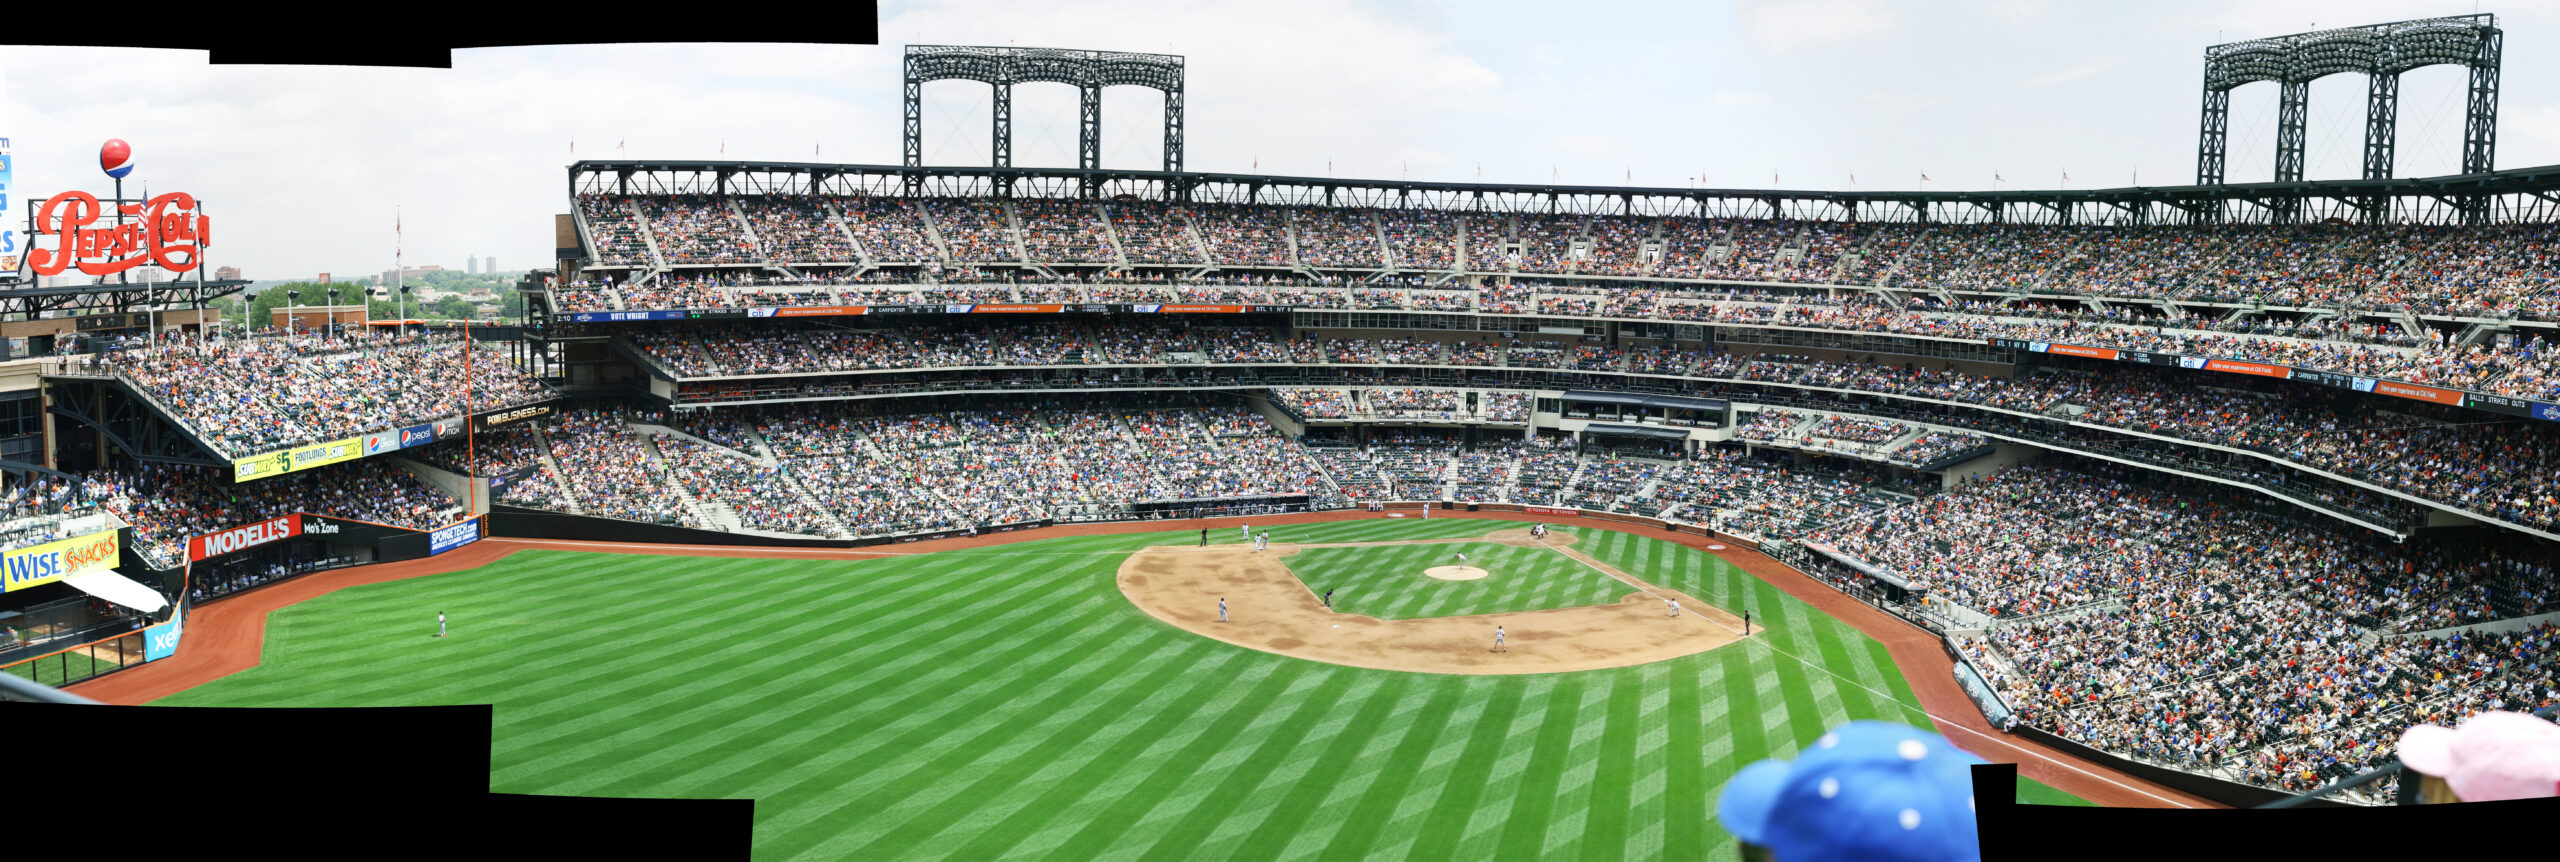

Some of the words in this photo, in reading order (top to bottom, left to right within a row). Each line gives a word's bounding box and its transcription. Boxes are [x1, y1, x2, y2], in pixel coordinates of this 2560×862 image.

[610, 312, 626, 320] VOTE
[2298, 372, 2318, 381] CARPENTER
[2469, 394, 2484, 402] BALLS
[2488, 397, 2508, 405] STRIKES
[412, 428, 430, 442] pepsi
[329, 440, 361, 460] SUBWAY
[237, 456, 276, 478] SUBWAY
[276, 451, 291, 472] $5
[304, 523, 320, 534] Mo's
[321, 522, 339, 534] Zone
[205, 518, 290, 558] MODELL'S
[64, 533, 116, 576] SNACKS
